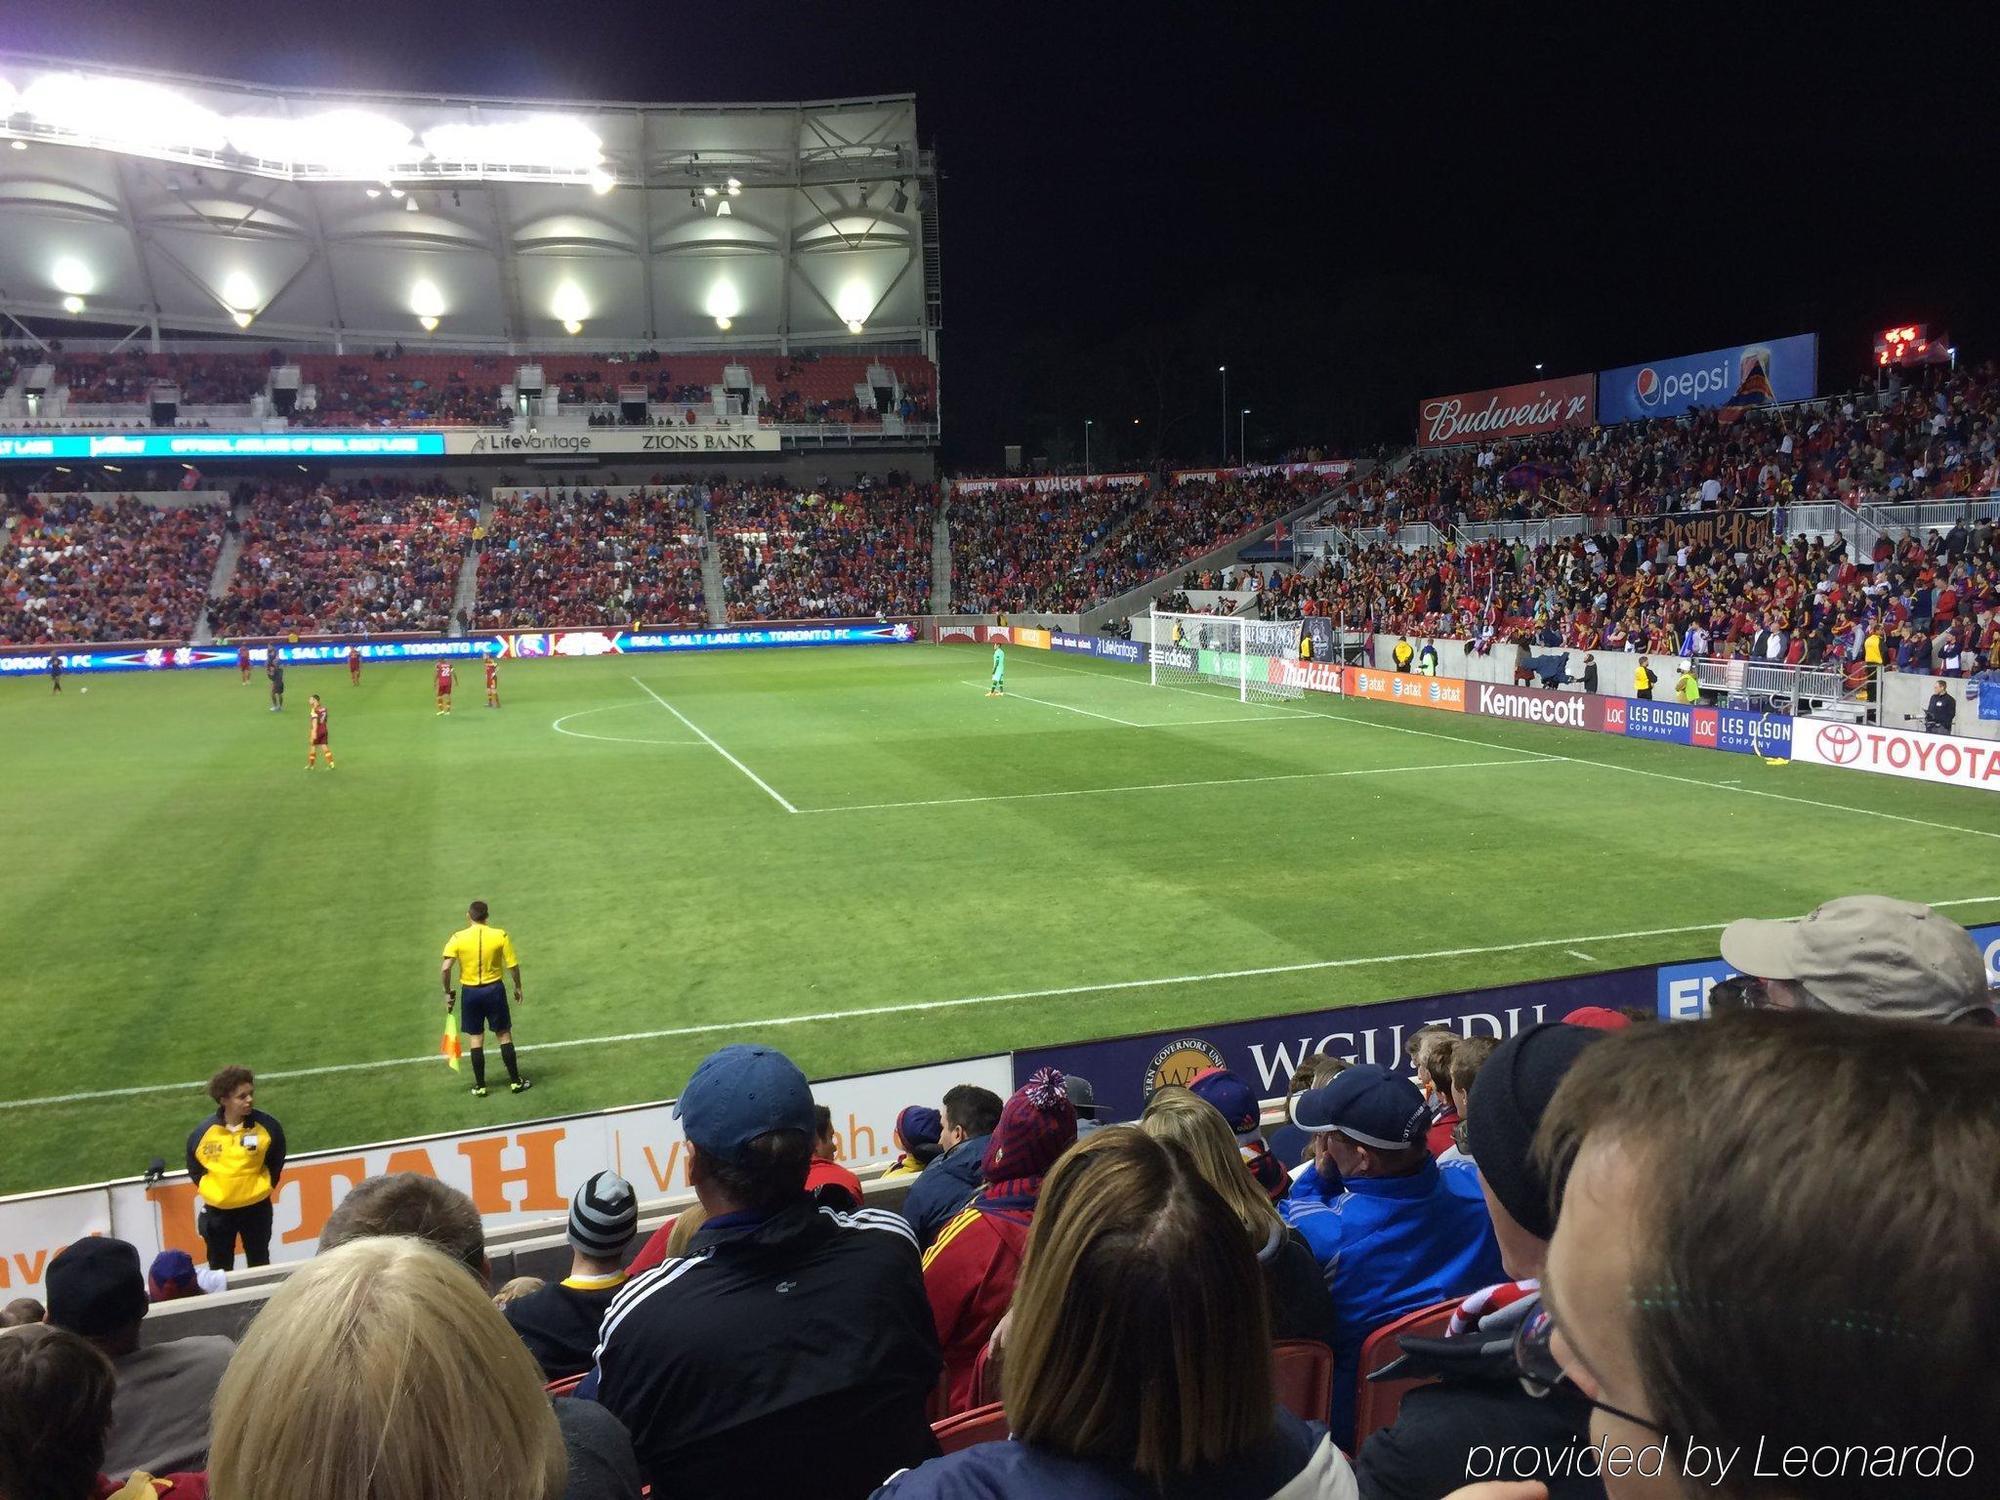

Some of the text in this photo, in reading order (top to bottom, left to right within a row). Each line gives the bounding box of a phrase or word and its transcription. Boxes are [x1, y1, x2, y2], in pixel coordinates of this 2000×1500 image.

[1663, 360, 1729, 405] pepsi
[491, 434, 591, 452] LifeVantage
[642, 434, 755, 450] ZIONS BANK
[669, 633, 704, 646] SALT
[706, 632, 740, 645] LAKE
[768, 630, 832, 642] TORONTO
[834, 628, 850, 640] FC
[291, 646, 330, 660] SALT
[401, 642, 470, 656] TORONTO
[474, 641, 492, 653] FC
[1102, 639, 1138, 663] LifeVantage
[72, 655, 92, 668] FC
[1368, 677, 1386, 693] at&t
[1402, 681, 1421, 698] at&t
[1441, 685, 1461, 703] at&t
[1480, 685, 1585, 728] Kennecott
[1606, 708, 1624, 724] LOC
[1629, 706, 1690, 728] LES OLSON
[1629, 723, 1672, 736] COMPANY
[1695, 721, 1715, 737] LOC
[1721, 717, 1791, 742] LES OLSON
[1721, 736, 1772, 749] COMPANY
[1867, 734, 2000, 781] TOYOTA
[1154, 1040, 1208, 1066] GOVERNORS
